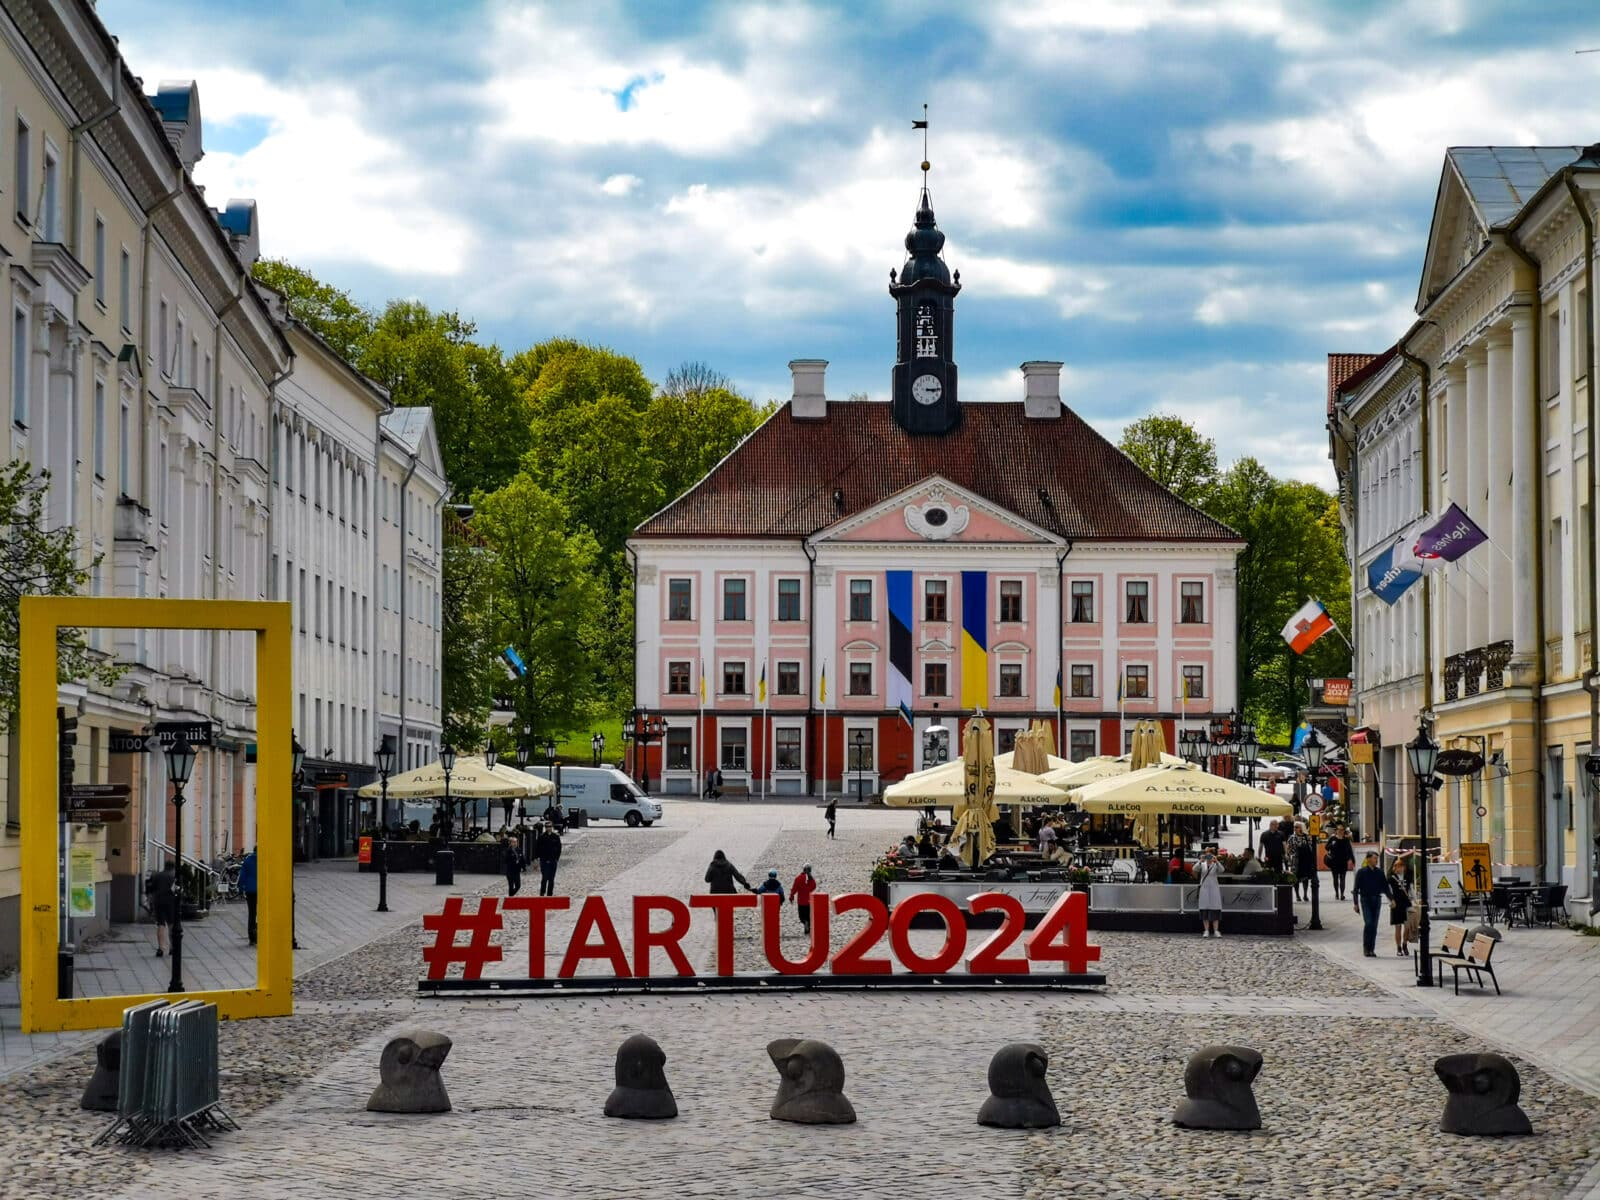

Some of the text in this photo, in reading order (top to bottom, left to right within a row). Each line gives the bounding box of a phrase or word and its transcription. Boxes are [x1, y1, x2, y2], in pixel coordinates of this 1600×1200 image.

[1145, 785, 1226, 795] A.LeCoq
[908, 796, 937, 805] A.LeCoq
[1020, 795, 1050, 804] A.LeCoq
[1108, 803, 1142, 812] A.LeCoq
[1171, 803, 1206, 813] A.LeCoq
[1236, 806, 1270, 816] A.LeCoq
[423, 891, 1102, 980] #TARTU2024
